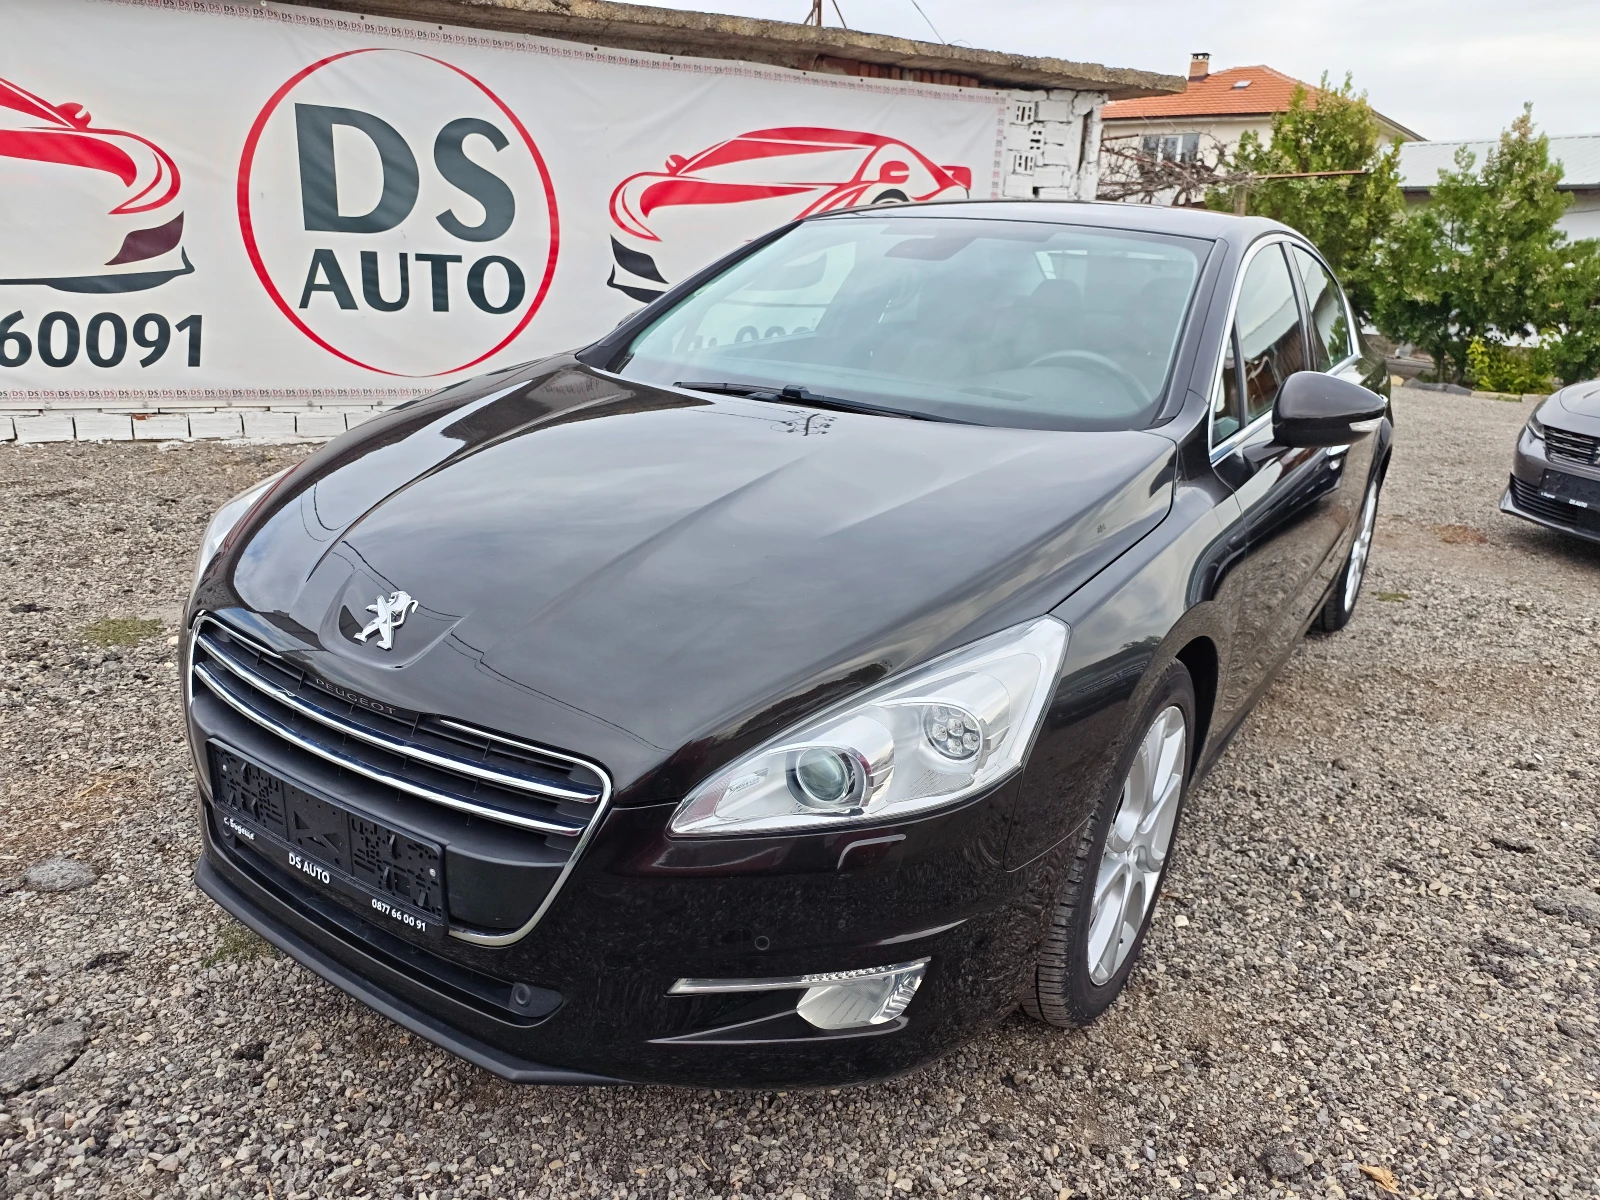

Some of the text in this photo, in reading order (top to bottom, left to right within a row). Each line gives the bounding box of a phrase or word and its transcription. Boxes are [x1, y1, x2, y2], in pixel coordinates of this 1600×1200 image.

[294, 102, 516, 243] DS
[298, 247, 526, 315] AUTO
[0, 311, 203, 368] 60091
[316, 678, 397, 714] PEUGEOT
[288, 851, 330, 884] DS AUTO
[371, 898, 426, 932] 0877 66 00 91
